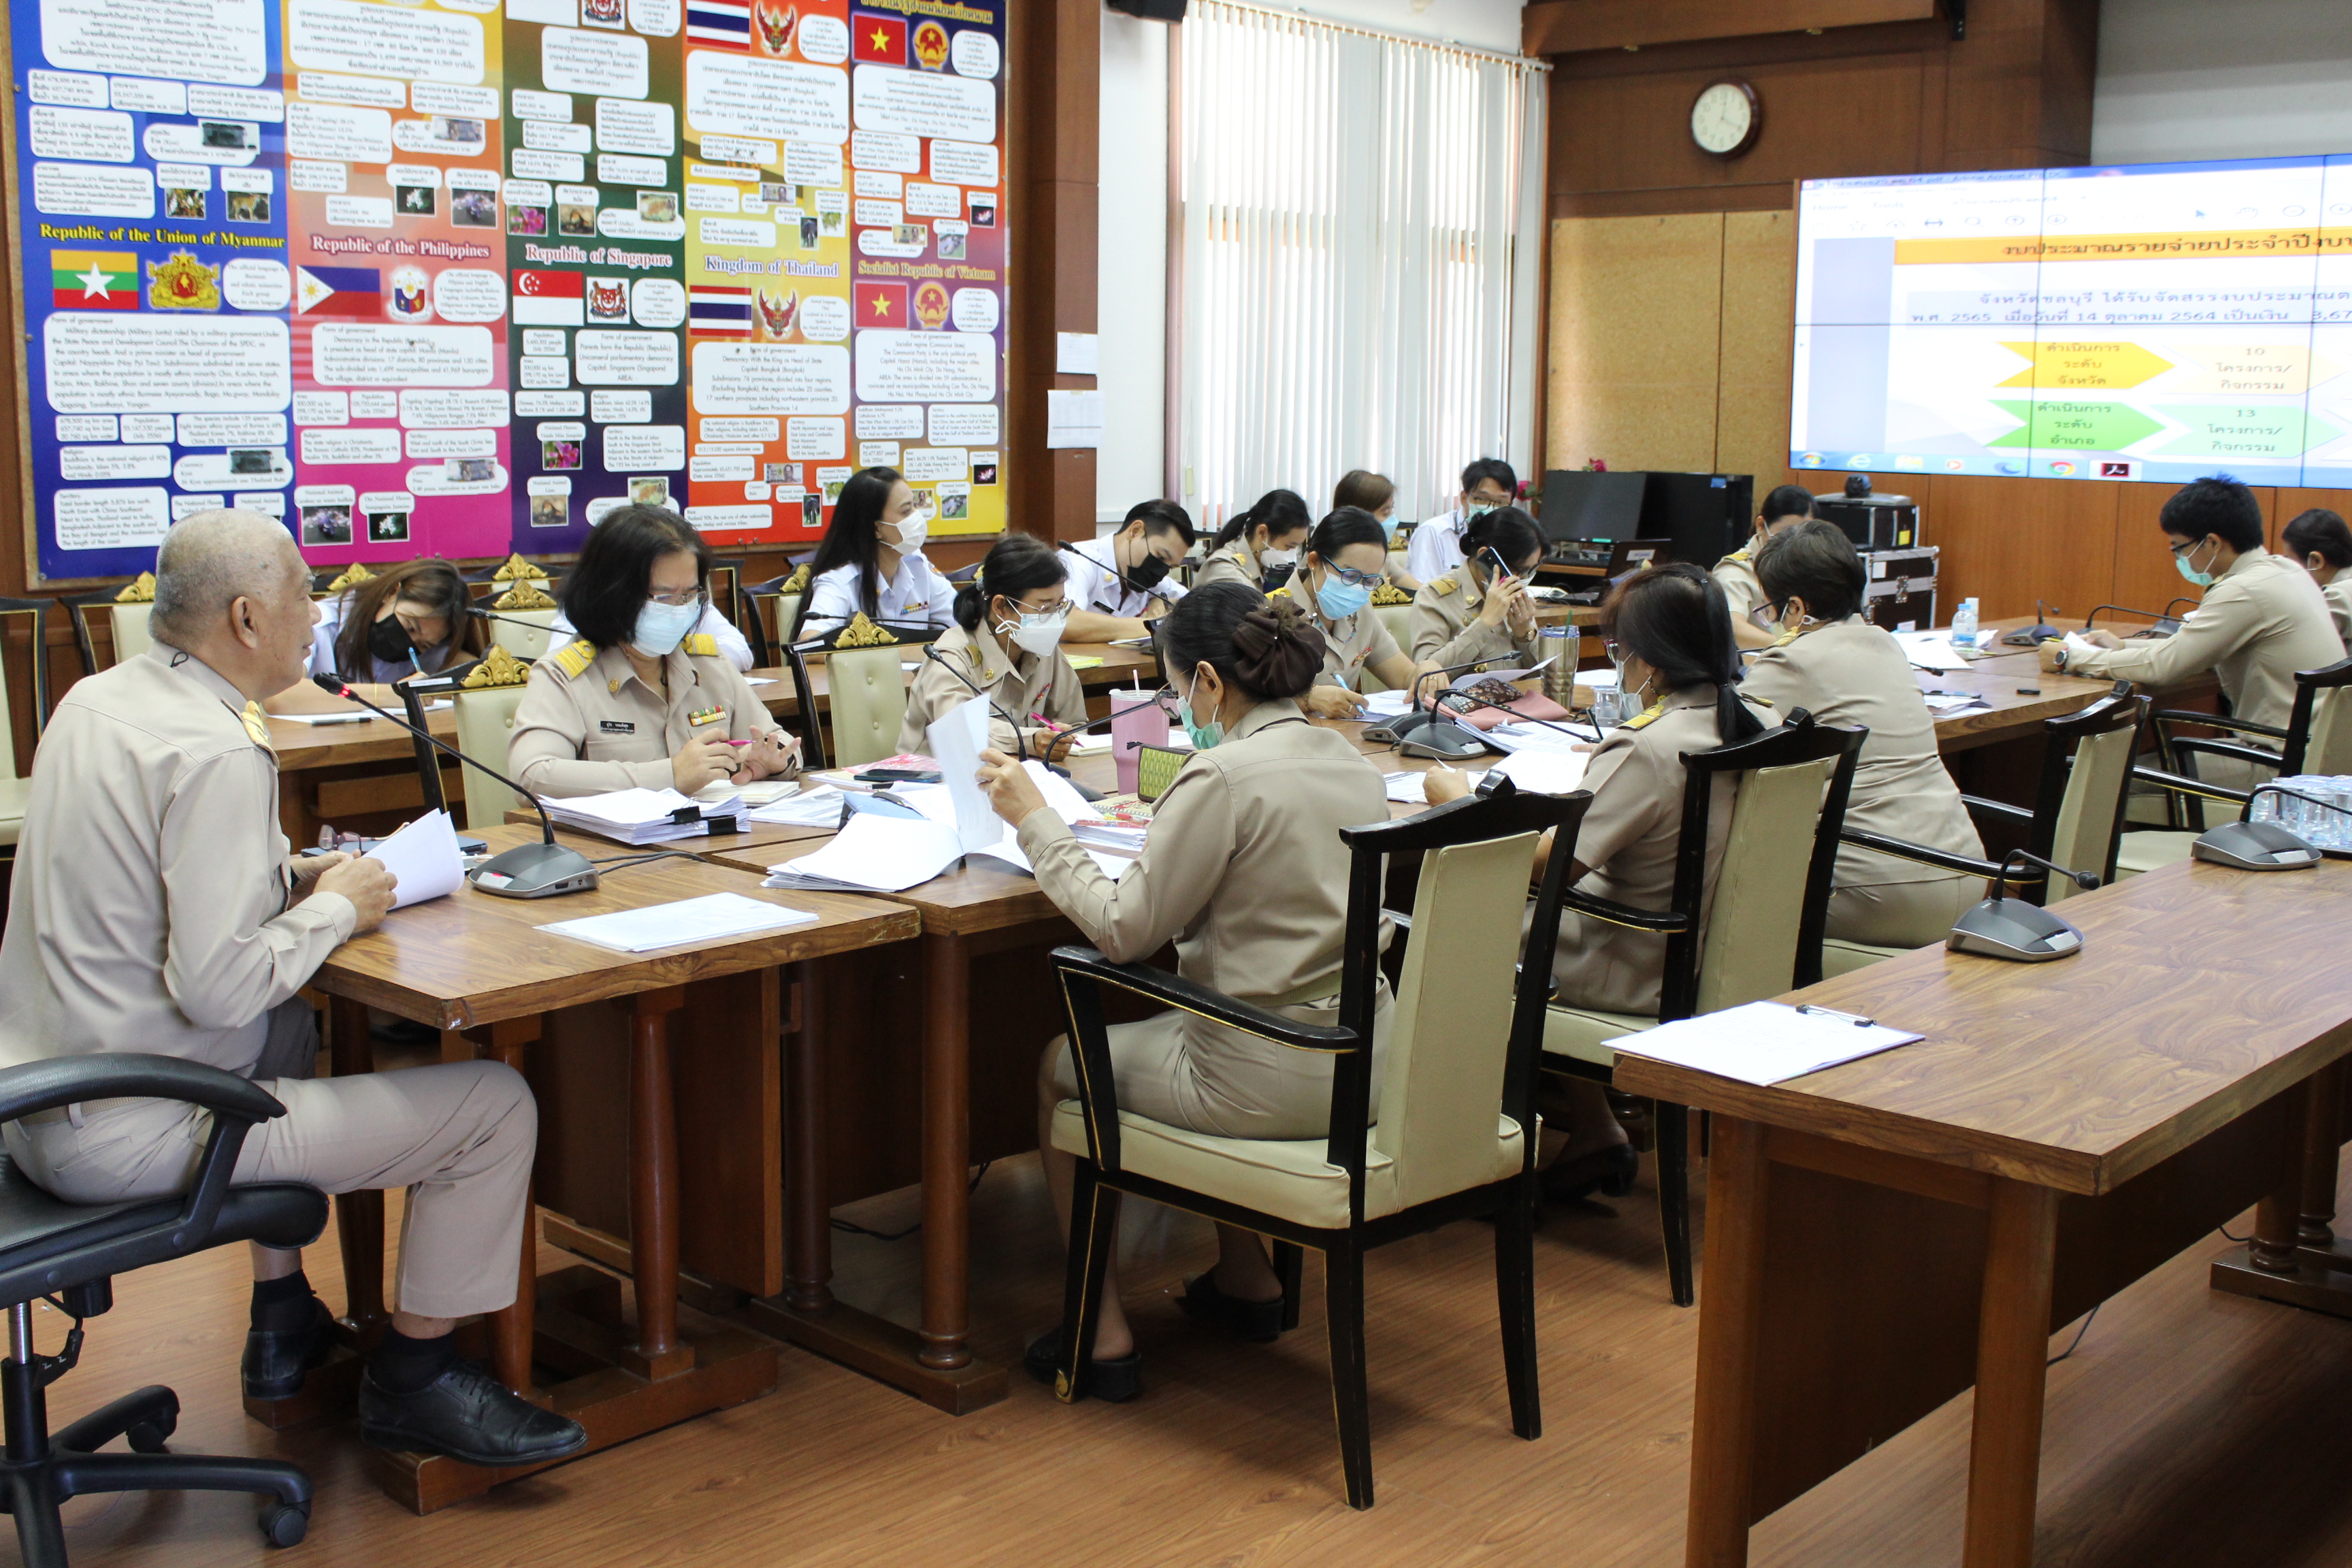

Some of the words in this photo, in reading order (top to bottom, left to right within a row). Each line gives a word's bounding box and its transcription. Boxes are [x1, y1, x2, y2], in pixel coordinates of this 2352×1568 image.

[39, 223, 105, 241] Republic
[109, 227, 124, 241] of
[128, 228, 151, 242] the
[156, 229, 198, 244] Union
[201, 231, 217, 245] of
[220, 231, 285, 249] Myanmar
[312, 235, 373, 254] Republic
[376, 239, 391, 254] of
[395, 240, 416, 255] the
[419, 240, 491, 260] Philippines
[525, 244, 587, 265] Republic
[589, 246, 604, 264] of
[607, 247, 673, 269] Singapore
[704, 255, 764, 276] Kingdom
[767, 259, 781, 274] of
[784, 259, 839, 278] Thailand
[858, 260, 899, 275] Socialist
[901, 262, 943, 279] Republic
[945, 264, 956, 278] of
[957, 265, 996, 280] Vietnam
[1951, 313, 1991, 323] 2565
[2076, 312, 2097, 322] 14
[2170, 311, 2216, 322] 2564
[2046, 342, 2121, 353] ดำเนินการ
[2245, 347, 2266, 356] 10
[930, 358, 948, 366] including
[2063, 358, 2102, 369] ระดับ
[610, 364, 635, 372] Singapore
[2057, 375, 2107, 386] จังหวัด
[2220, 379, 2285, 390] กิจกรรม
[759, 395, 780, 403] including
[2038, 403, 2111, 414] ดำเนินการ
[2236, 409, 2255, 418] 13
[2054, 419, 2093, 430] ระดับ
[2050, 436, 2095, 446] อำเภอ
[2211, 441, 2275, 453] กิจกรรม
